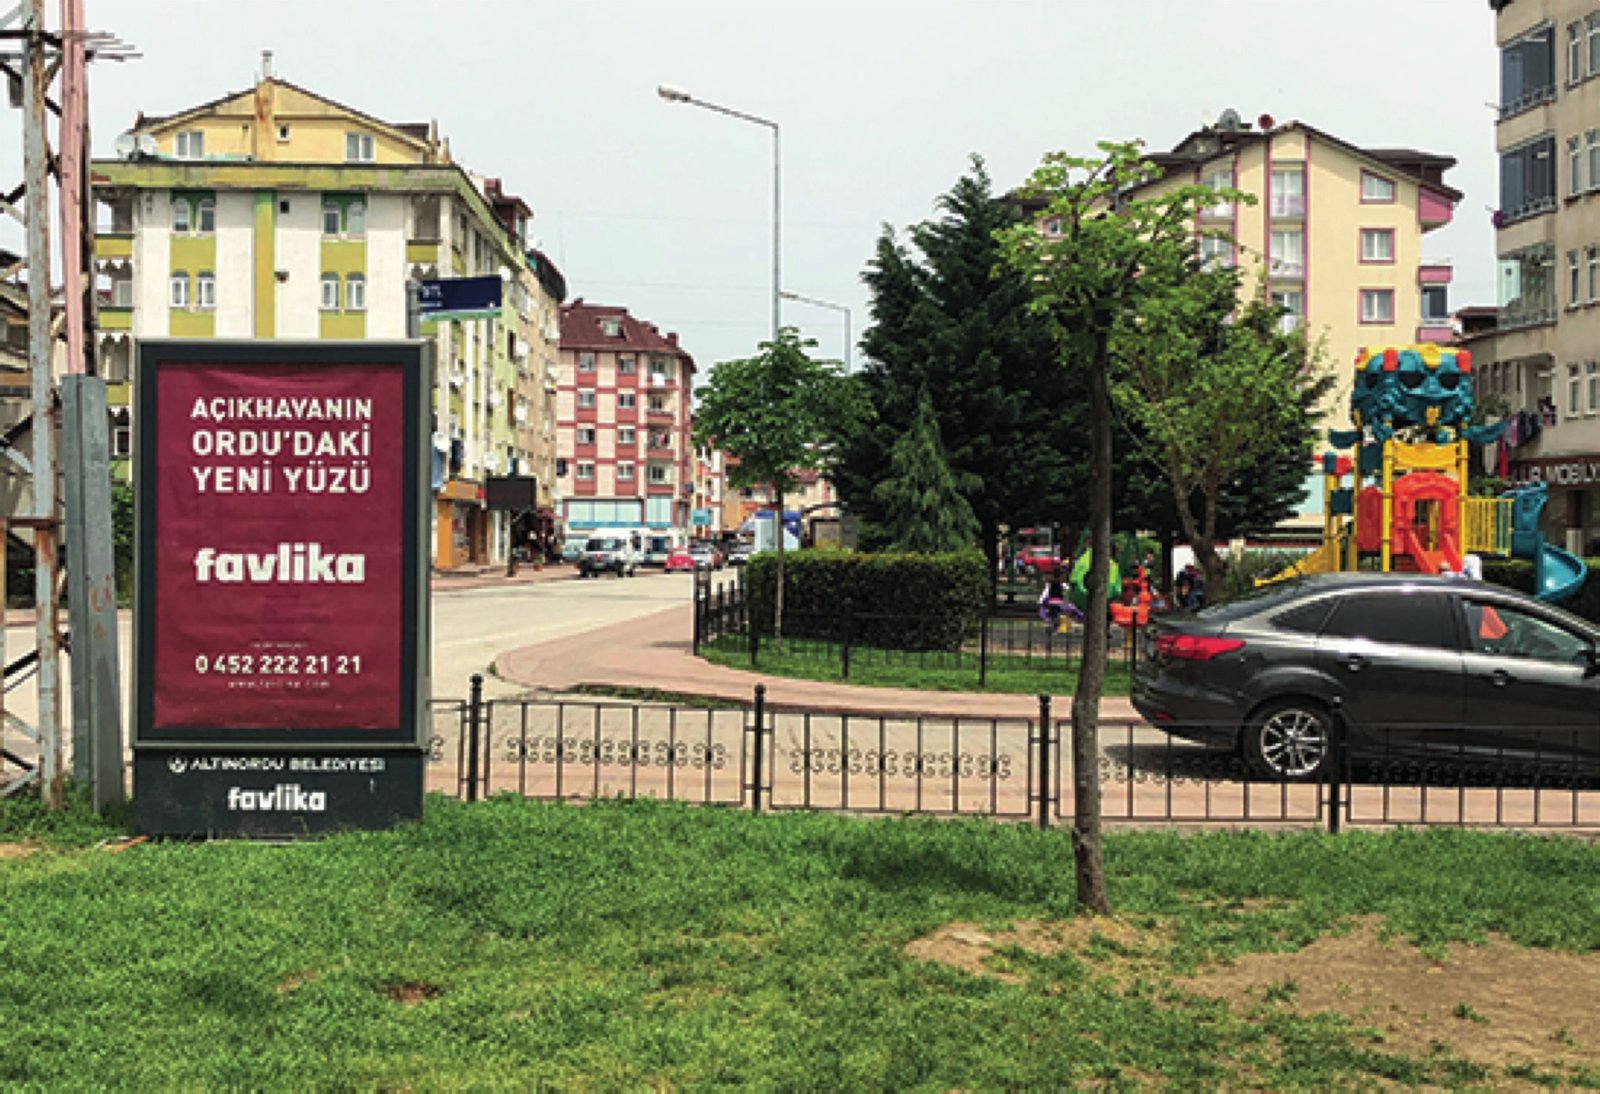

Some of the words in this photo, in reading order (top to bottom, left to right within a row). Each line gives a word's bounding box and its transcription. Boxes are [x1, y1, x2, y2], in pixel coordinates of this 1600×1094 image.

[190, 397, 372, 422] AÇIKHAVANIN
[192, 423, 370, 456] ORDU'DAKİ
[191, 460, 272, 493] YENİ
[283, 460, 370, 493] YÜZÜ
[193, 542, 366, 583] favlika
[195, 655, 208, 674] 0
[213, 655, 254, 674] 452
[259, 655, 299, 674] 222
[305, 655, 329, 674] 21
[336, 655, 361, 674] 21
[190, 757, 285, 771] ALTINORDU
[227, 783, 327, 812] favlika
